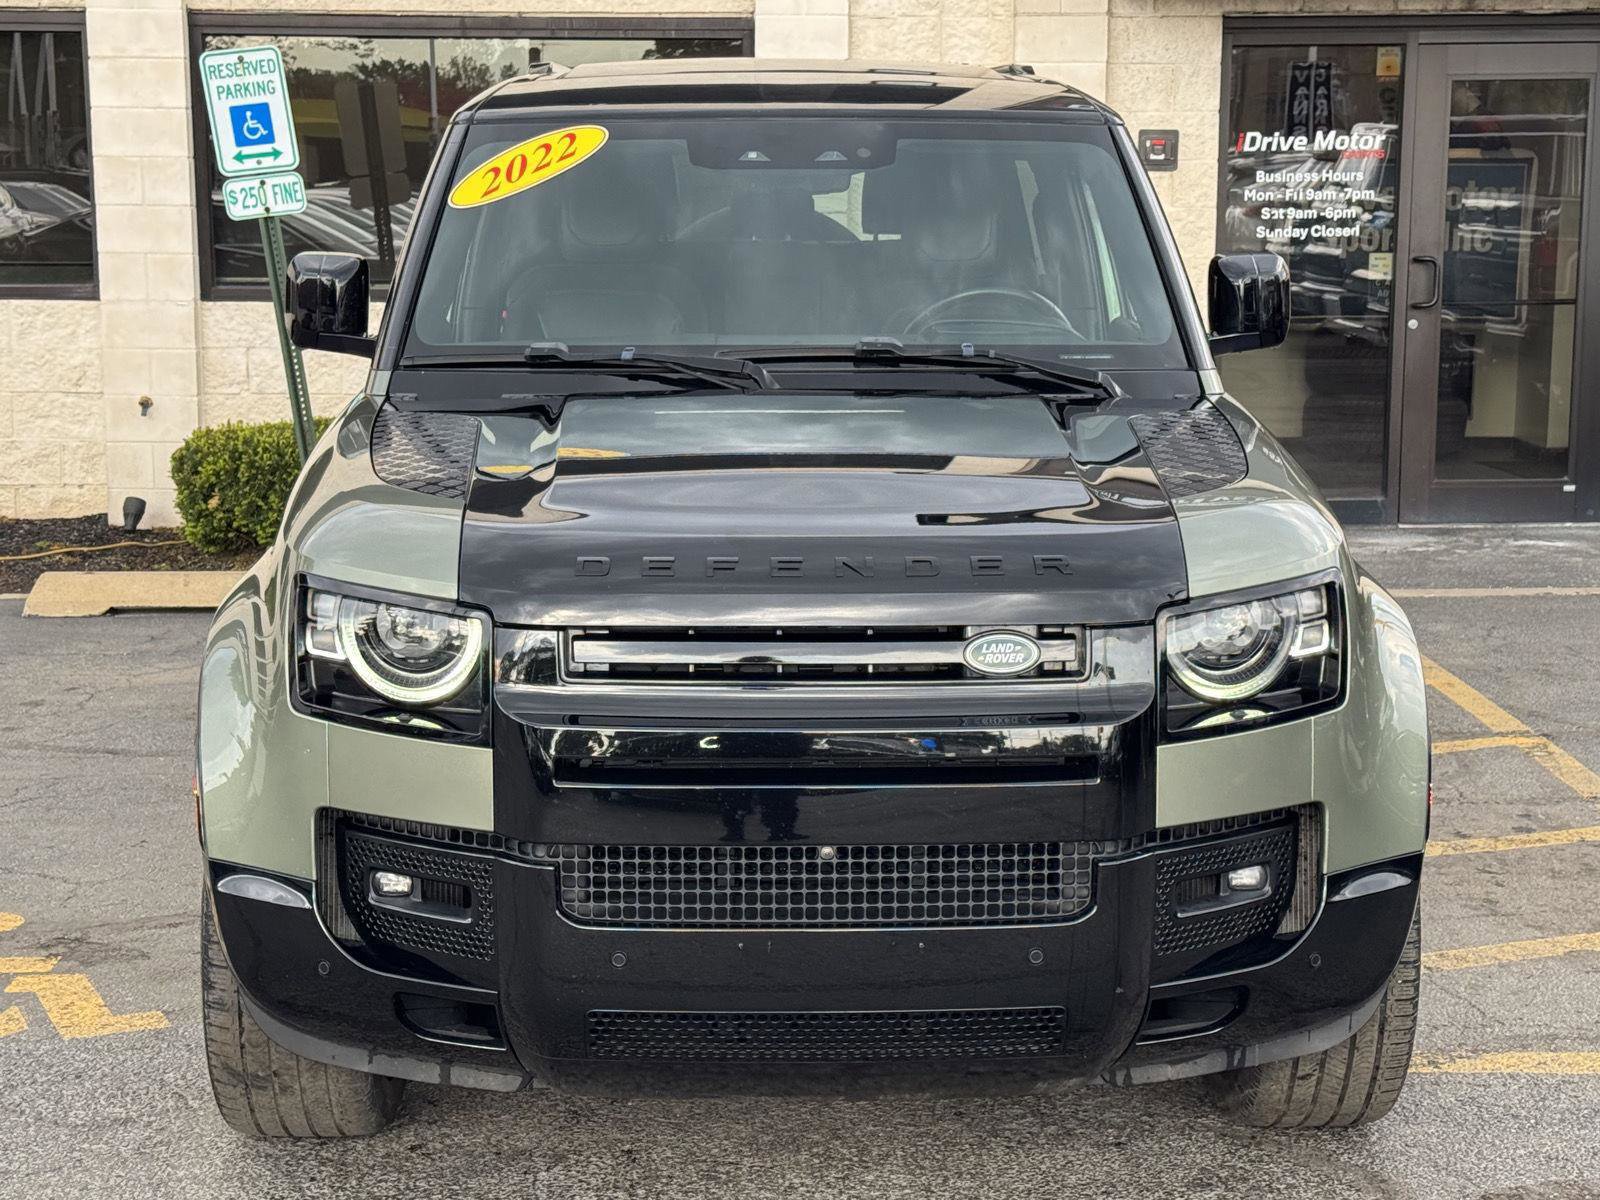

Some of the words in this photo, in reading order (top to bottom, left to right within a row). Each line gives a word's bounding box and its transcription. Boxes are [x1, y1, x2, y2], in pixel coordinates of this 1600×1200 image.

[207, 58, 276, 80] RESERVED
[216, 80, 276, 101] PARKING
[1236, 131, 1308, 152] iDrive
[1313, 130, 1387, 151] Motor
[480, 132, 578, 199] 2022
[1255, 170, 1319, 183] Business
[1322, 170, 1364, 183] Hours
[272, 181, 303, 205] FINE
[1243, 188, 1274, 201] Mon
[1305, 188, 1337, 201] 9am
[1286, 206, 1318, 220] 9am
[1255, 225, 1309, 241] Sunday
[1310, 224, 1360, 238] Closed
[574, 553, 1074, 579] DEFENDER
[981, 643, 1014, 653] LAND
[984, 653, 1024, 663] ROVER
